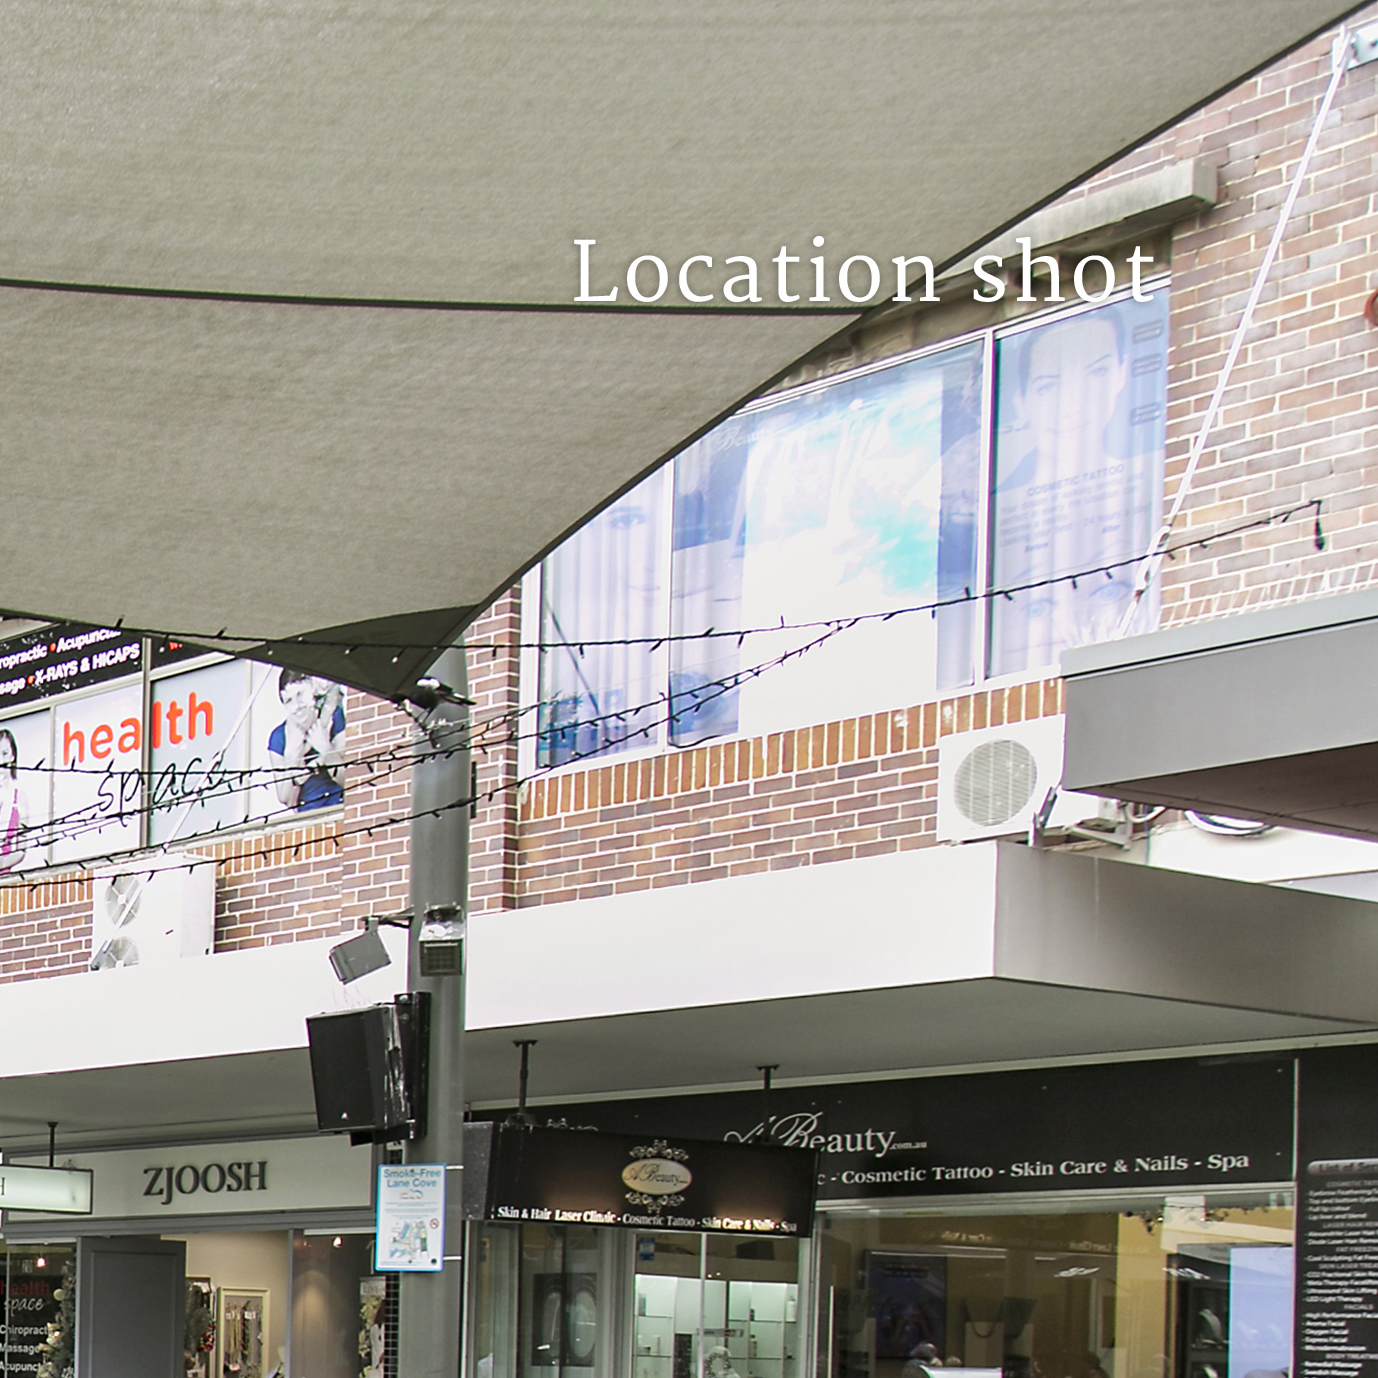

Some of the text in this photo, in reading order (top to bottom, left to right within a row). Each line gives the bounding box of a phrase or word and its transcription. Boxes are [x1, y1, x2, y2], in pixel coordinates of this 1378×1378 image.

[34, 658, 79, 687] X-RAYS
[79, 656, 91, 673] &
[91, 642, 141, 670] HICAPS
[63, 691, 213, 766] health
[143, 1160, 268, 1205] ZJOOSH
[383, 1168, 441, 1178] Smoke-Free
[387, 1178, 437, 1188] Lane Cove
[841, 1166, 927, 1185] Cosmetic
[932, 1164, 994, 1182] Tattoo
[1010, 1159, 1054, 1178] Skin
[1060, 1158, 1107, 1176] Care
[1113, 1157, 1129, 1173] &
[1135, 1154, 1189, 1172] Nails
[1207, 1152, 1250, 1173] Spa
[497, 1205, 519, 1218] Skin
[521, 1208, 528, 1219] &
[530, 1208, 552, 1220] Hair
[554, 1209, 582, 1222] Laser
[583, 1210, 616, 1224] Clinic
[622, 1213, 664, 1226] Cosmetic
[666, 1215, 695, 1227] Tattoo
[701, 1216, 721, 1228] Skin
[722, 1217, 744, 1230] Care
[780, 1220, 797, 1232] Spa
[0, 1324, 48, 1337] Chiropract
